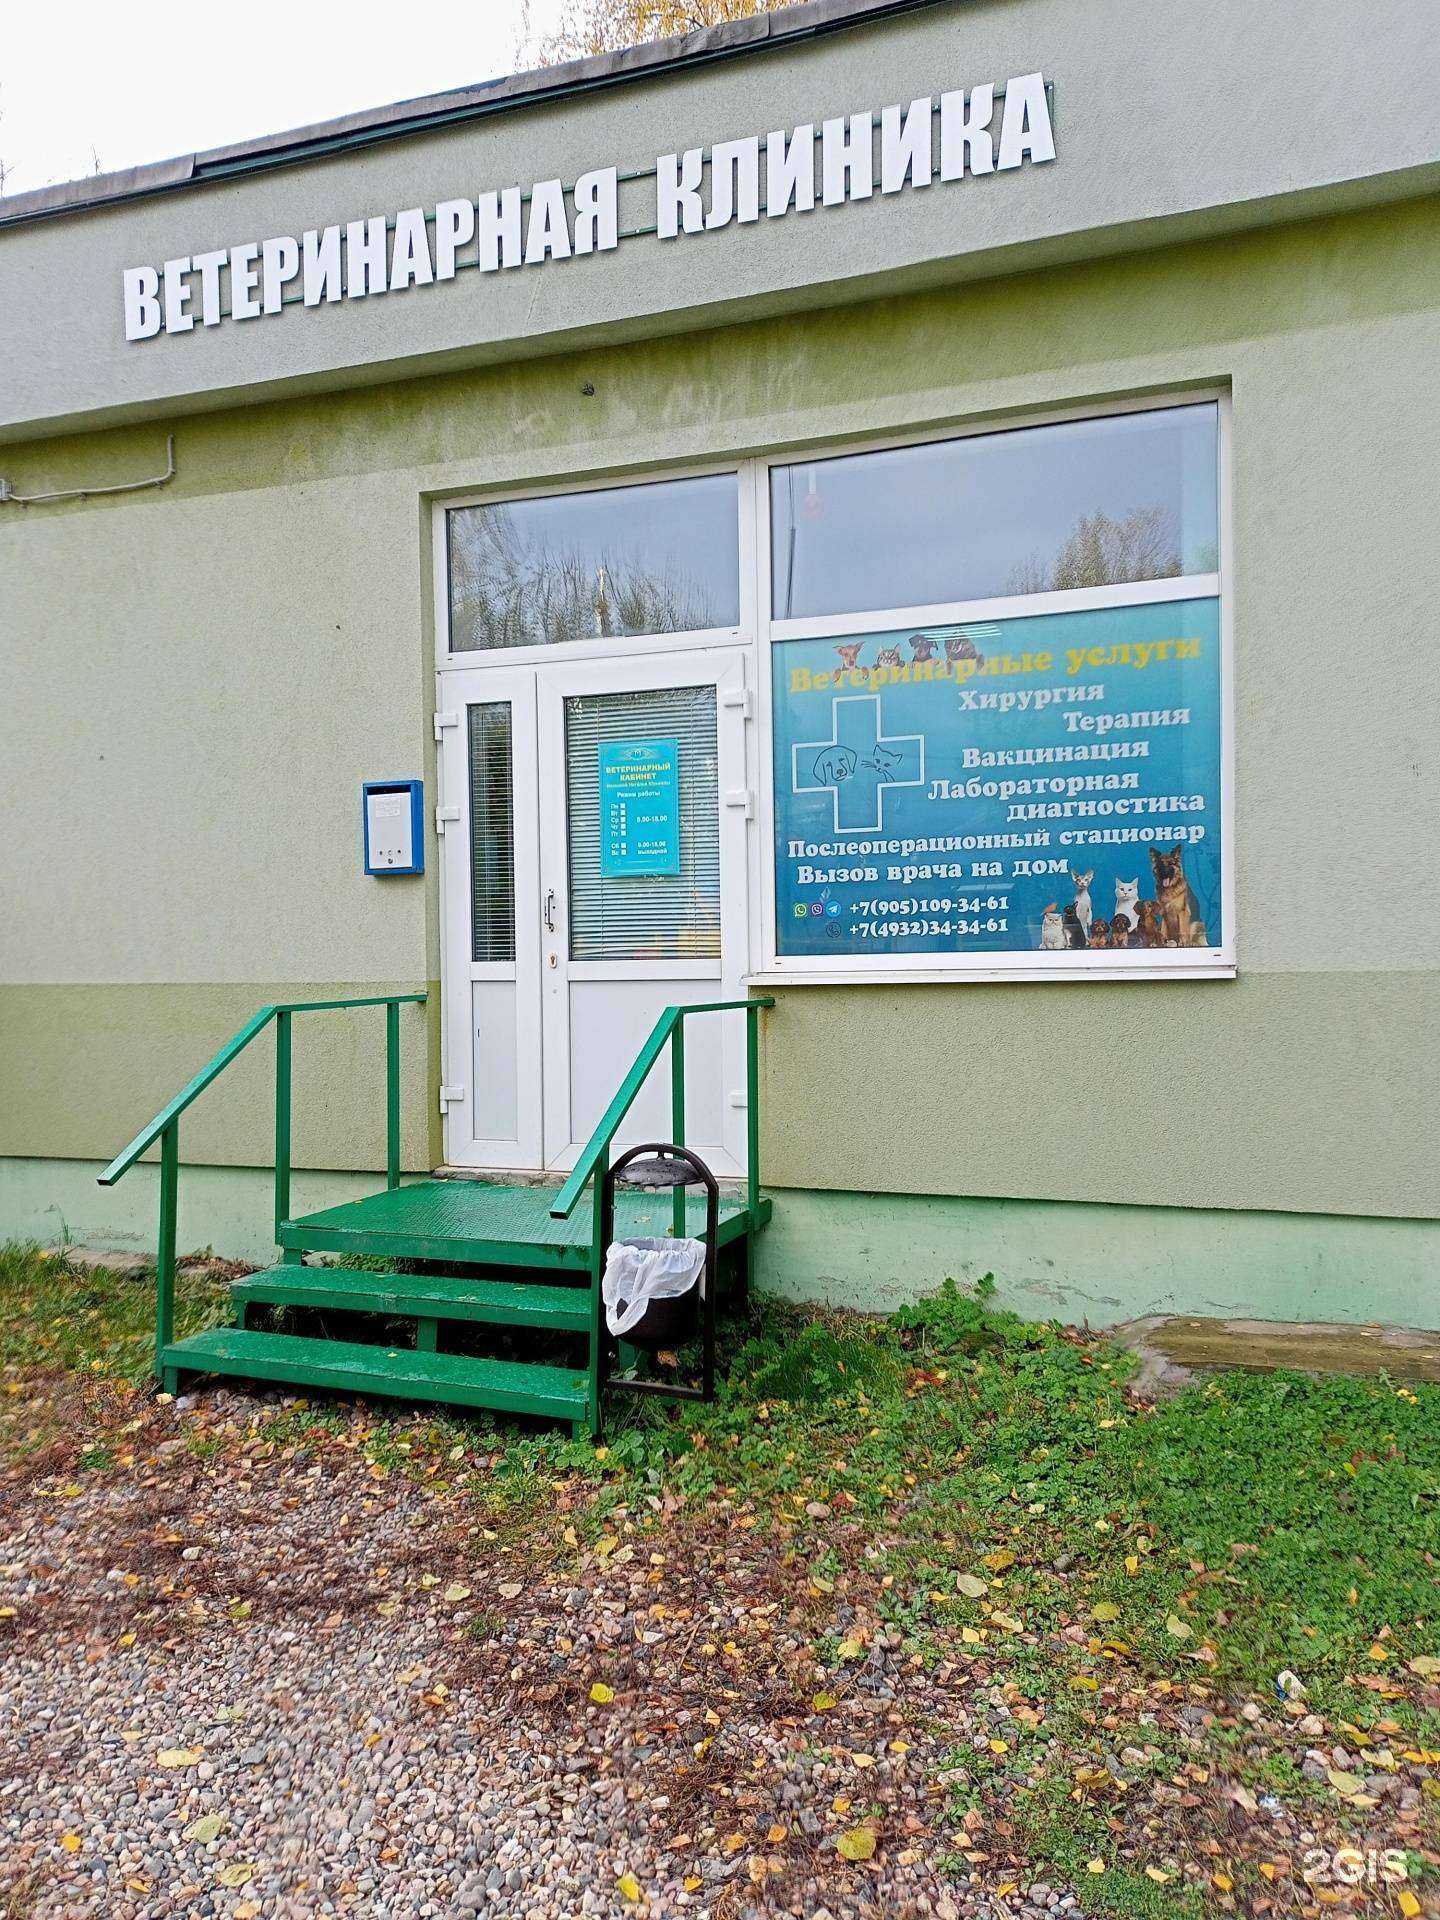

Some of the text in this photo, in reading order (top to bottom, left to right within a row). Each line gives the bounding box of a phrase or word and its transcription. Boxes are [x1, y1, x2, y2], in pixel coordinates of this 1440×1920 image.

[124, 71, 1056, 342] ВЕТЕРИНАРНАЯ КЛИНИКА
[789, 637, 1201, 694] Ветеринарные услуги
[958, 684, 1105, 712] Хирургия
[1062, 708, 1190, 735] Терапия
[605, 762, 671, 774] ВЕТЕРИНАРНЫЙ
[961, 741, 1150, 768] Вакцинация
[620, 772, 657, 781] КАБИНЕТ
[927, 772, 1140, 801] Лабораторная
[638, 789, 661, 799] работы
[1006, 795, 1206, 823] диагностика
[788, 824, 1206, 858] Послеоперационный стационар
[797, 858, 1069, 885] Вызов врача на дом
[849, 895, 1009, 917] +7(905)109-34-61
[849, 918, 1009, 939] +7(4932)34-34-61
